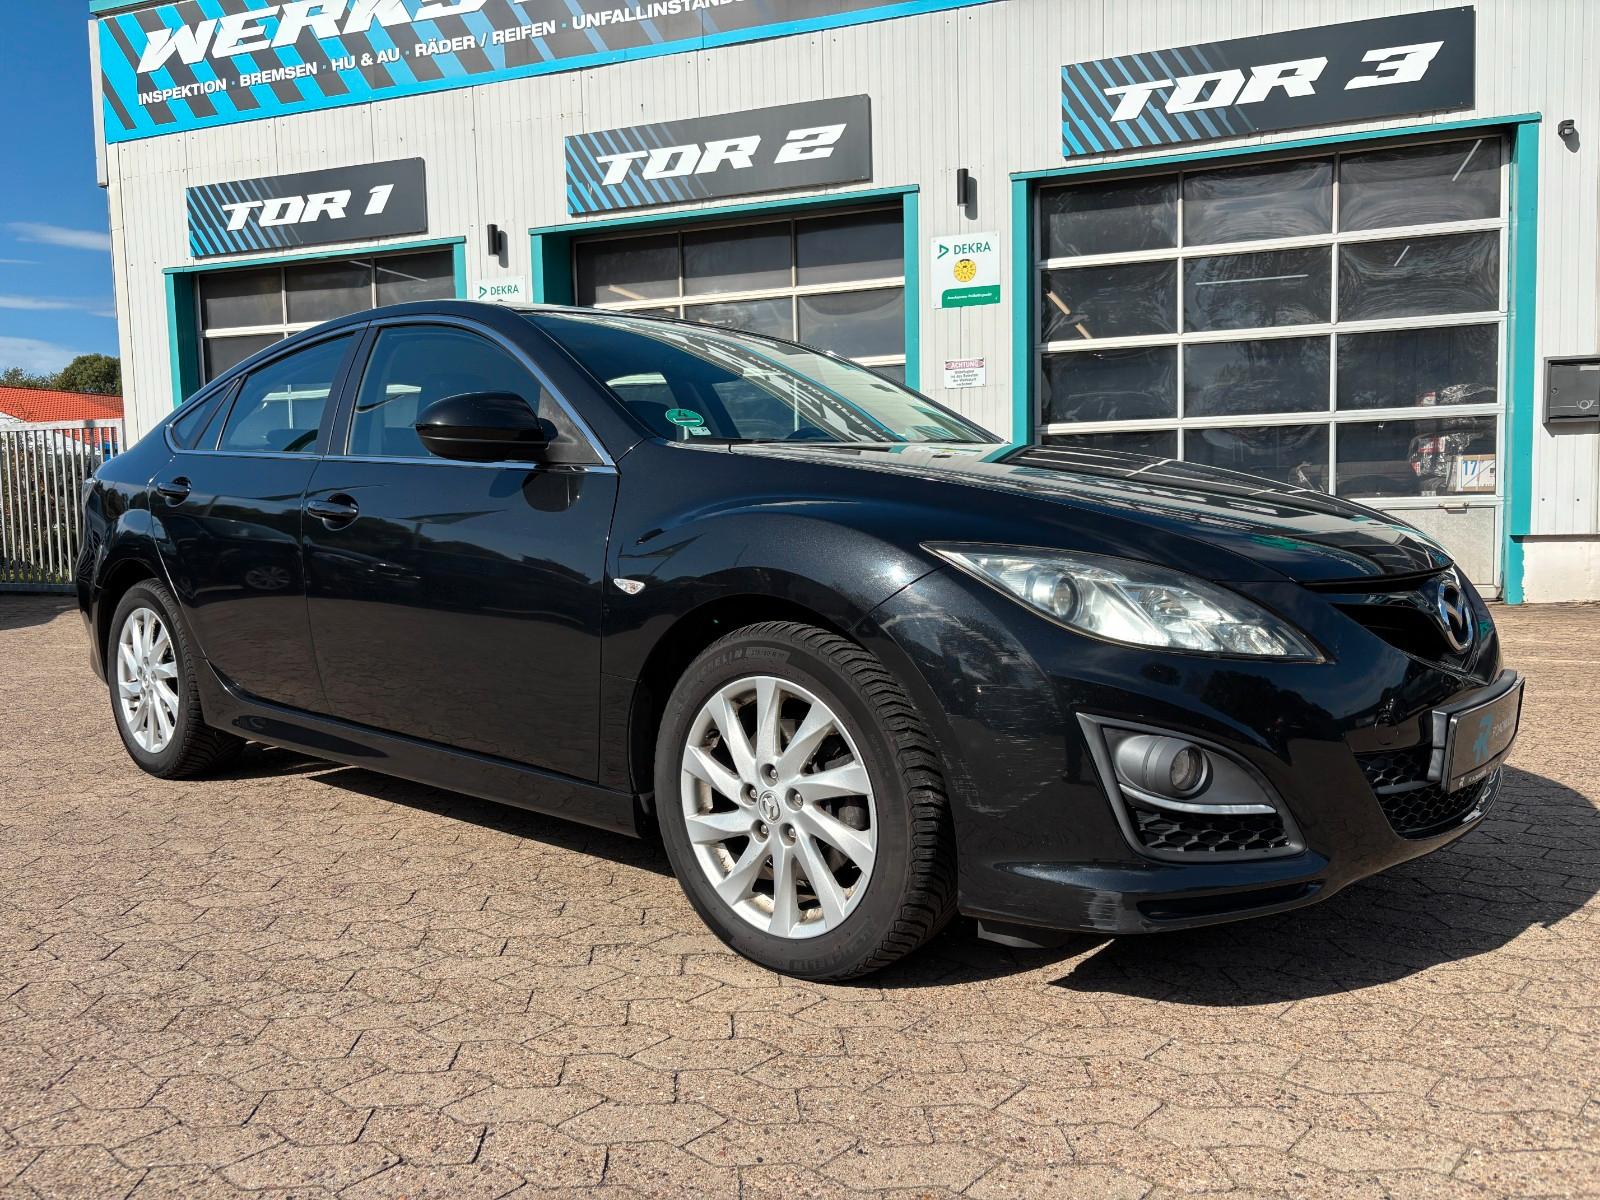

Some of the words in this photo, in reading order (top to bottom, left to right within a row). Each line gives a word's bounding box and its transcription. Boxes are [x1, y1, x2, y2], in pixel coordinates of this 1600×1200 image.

[138, 78, 227, 105] INSPEKTION
[239, 61, 318, 88] BREMSEN
[331, 55, 356, 71] HU
[360, 52, 374, 67] &
[376, 47, 400, 64] AU
[414, 36, 476, 58] RÄDER
[492, 19, 556, 45] REIFEN
[1104, 57, 1328, 122] TOR
[1344, 41, 1444, 90] 3
[596, 135, 761, 186] TOR
[774, 123, 847, 164] 2
[221, 189, 352, 231] TOR
[364, 184, 395, 216] 1
[953, 241, 992, 255] DEKRA
[490, 284, 520, 296] DEKRA
[951, 360, 979, 368] ACHTUNG
